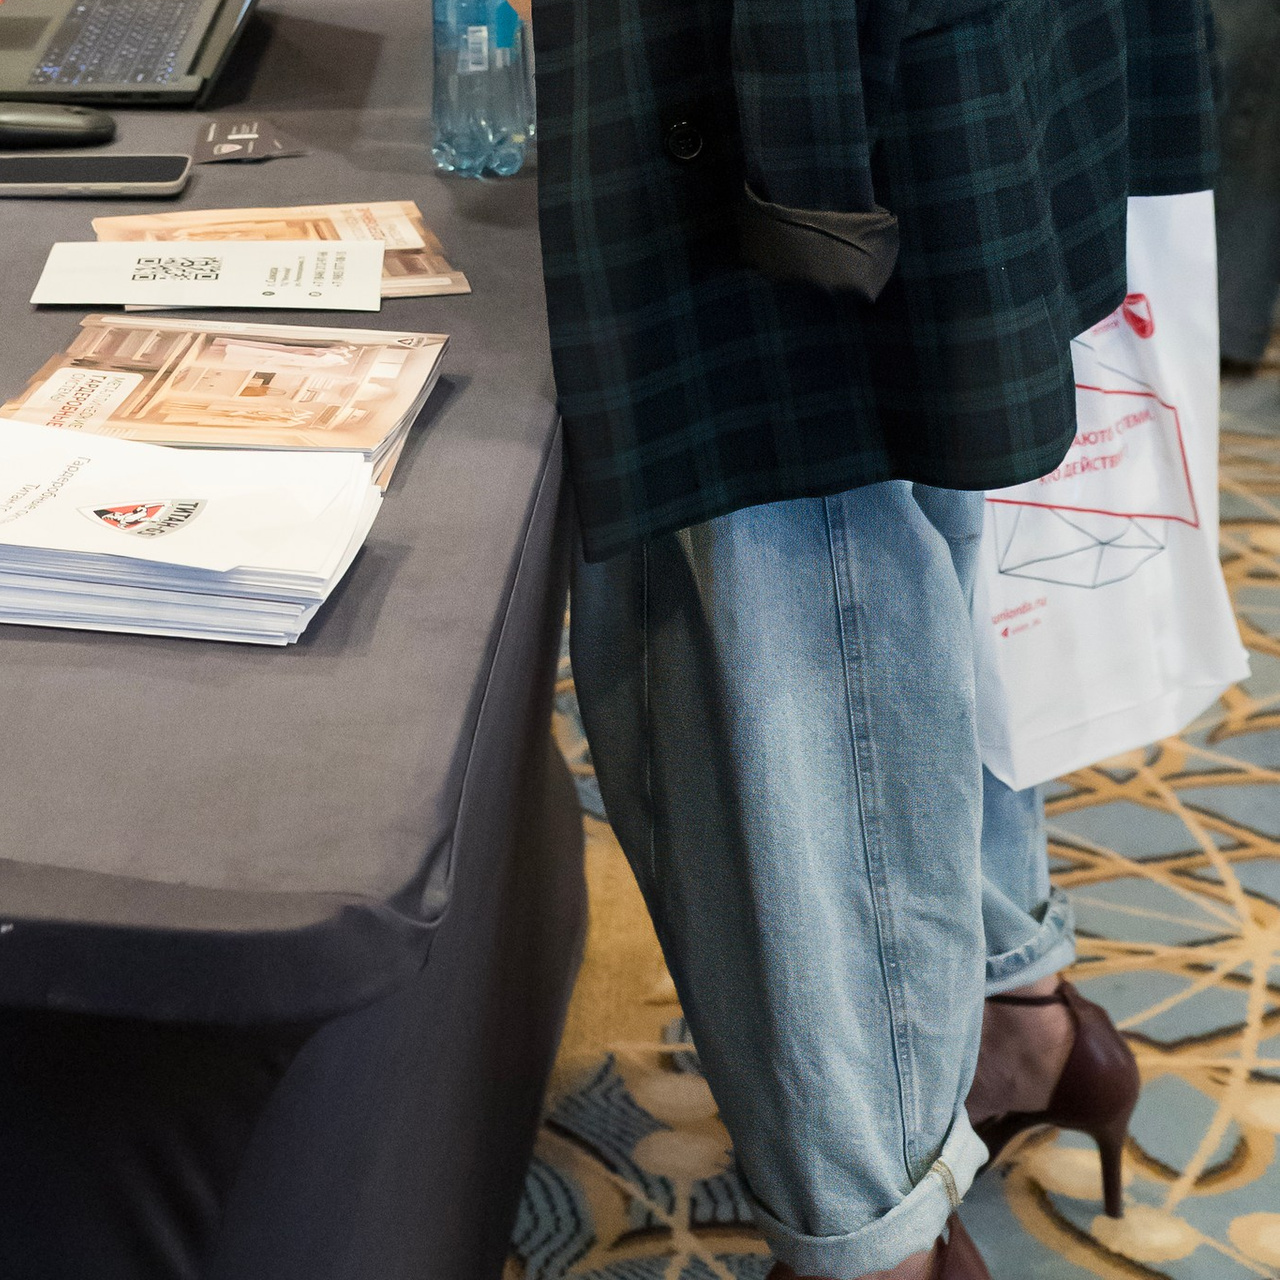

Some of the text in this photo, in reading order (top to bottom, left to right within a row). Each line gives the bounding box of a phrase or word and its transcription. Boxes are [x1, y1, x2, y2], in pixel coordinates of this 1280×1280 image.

[45, 375, 108, 428] ГАРДЕРОБНЫЕ
[26, 456, 92, 511] Гардеробные
[136, 502, 199, 537] ТИТАН-GS
